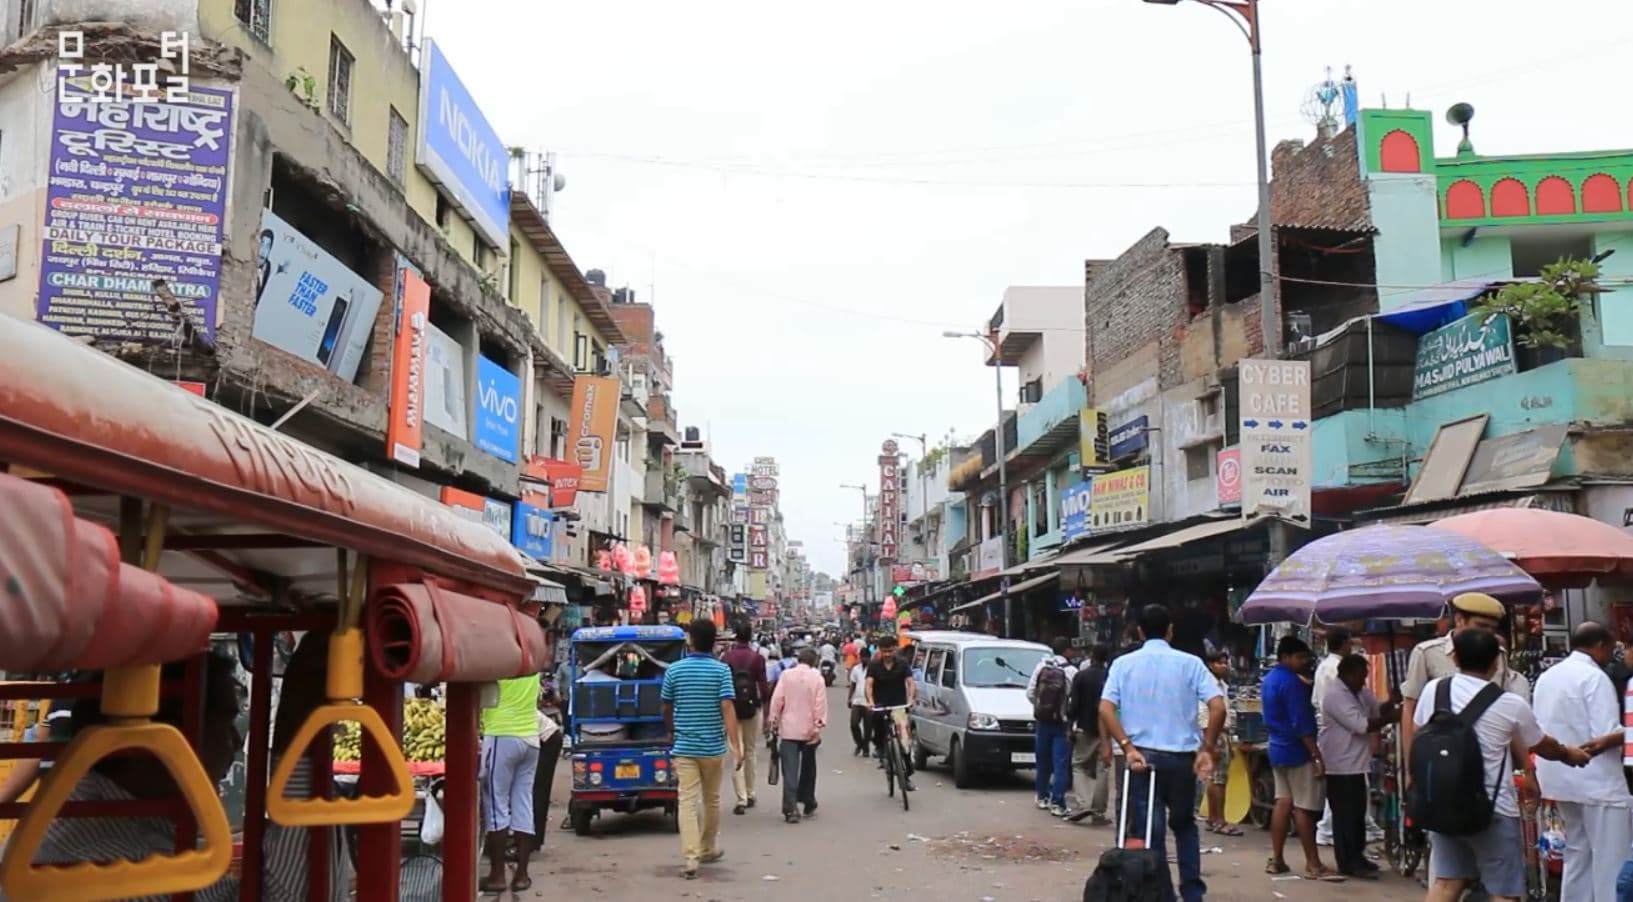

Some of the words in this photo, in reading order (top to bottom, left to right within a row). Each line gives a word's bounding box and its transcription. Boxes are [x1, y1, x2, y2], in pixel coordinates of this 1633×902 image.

[57, 129, 195, 159] टूरिस्ट
[440, 84, 502, 200] NOKIA
[49, 229, 93, 241] DAILY
[100, 233, 141, 246] TOUR
[146, 237, 216, 253] PACKAGE
[79, 220, 105, 232] TRAIN
[148, 228, 175, 239] HOTEL
[177, 231, 217, 243] BOOKING
[52, 241, 98, 257] दिल्ली
[52, 272, 98, 289] CHAR
[103, 277, 151, 293] DHAM
[295, 281, 319, 303] THAN
[299, 270, 329, 296] FASTER
[287, 293, 317, 317] FASTER
[1242, 363, 1308, 386] CYBER
[1414, 362, 1455, 389] MASJID
[478, 378, 518, 424] vivo
[1250, 393, 1299, 414] CAFE
[1095, 411, 1108, 463] Nikon
[1261, 443, 1291, 453] FAX
[751, 465, 778, 476] HOTEL
[1254, 466, 1297, 475] SCAN
[1263, 487, 1289, 496] AIR
[883, 466, 894, 558] CAPITAL
